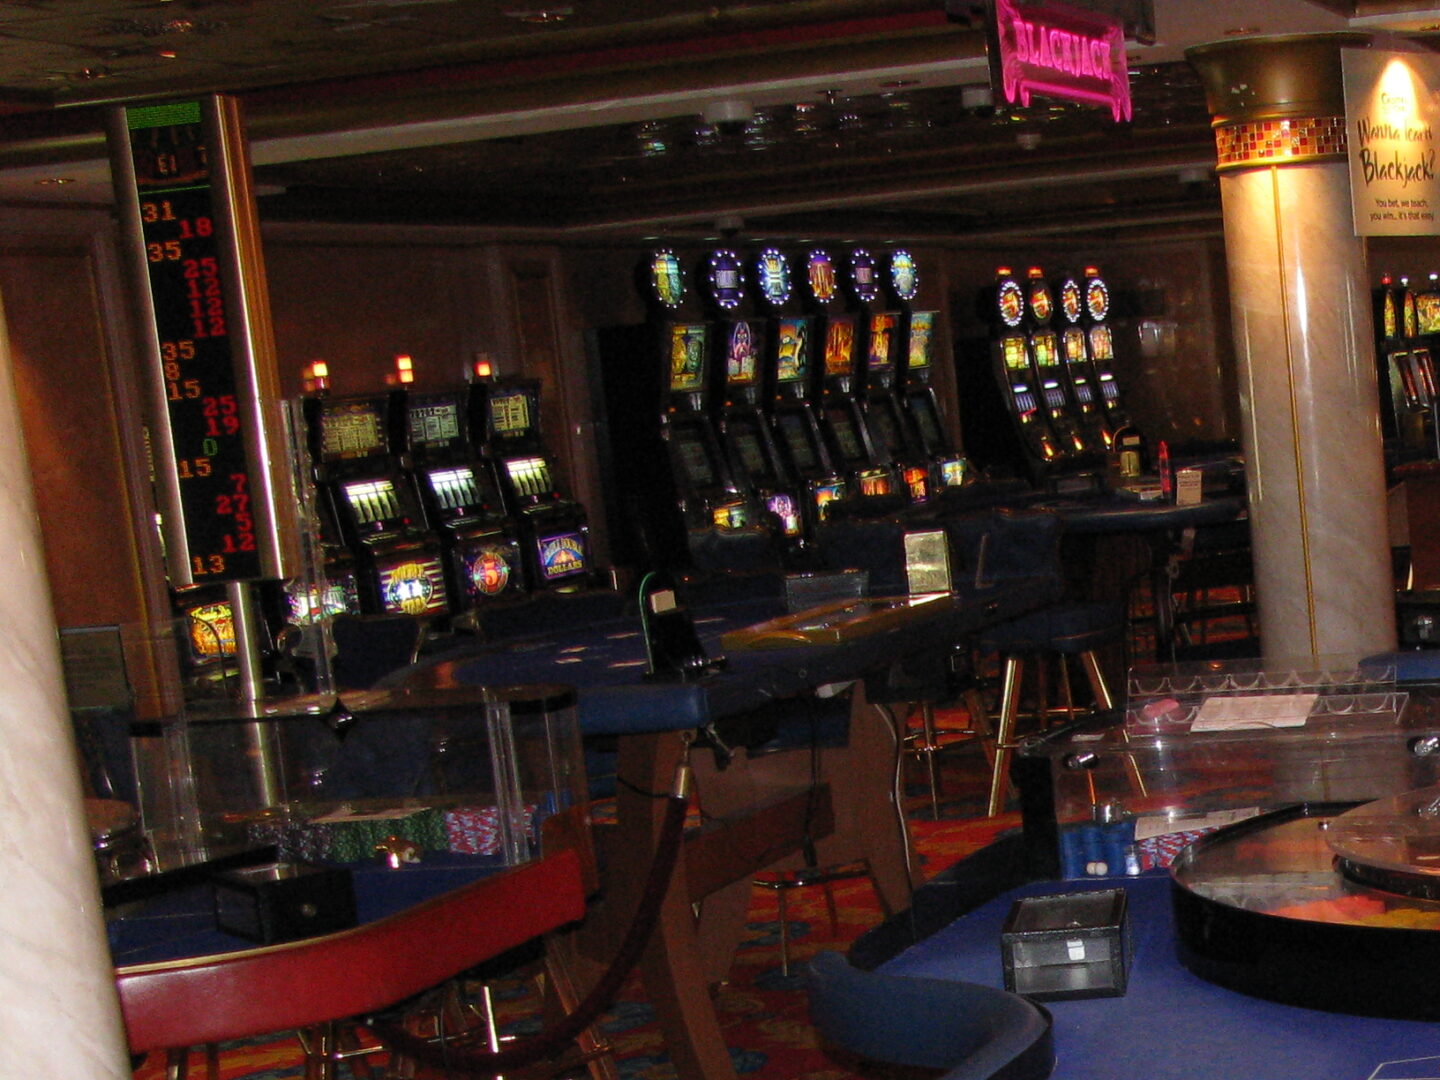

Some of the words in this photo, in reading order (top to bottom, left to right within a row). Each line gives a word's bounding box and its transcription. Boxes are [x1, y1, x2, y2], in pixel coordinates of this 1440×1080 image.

[1013, 21, 1111, 80] BLACKJACK
[1357, 116, 1400, 147] Wanna
[1359, 148, 1435, 188] Blackjack?
[142, 200, 176, 222] 31
[179, 217, 213, 239] 18
[148, 240, 182, 262] 35
[183, 257, 219, 279] 25
[187, 278, 221, 299] 12
[190, 297, 224, 318] 12
[194, 317, 226, 338] 12
[162, 340, 196, 361] 35
[167, 379, 201, 400] 15
[203, 395, 237, 417] 25
[206, 416, 240, 437] 19
[179, 458, 211, 479] 15
[230, 473, 248, 492] 7
[216, 493, 249, 514] 27
[235, 512, 253, 532] 5
[222, 533, 255, 553] 12
[193, 554, 225, 575] 13
